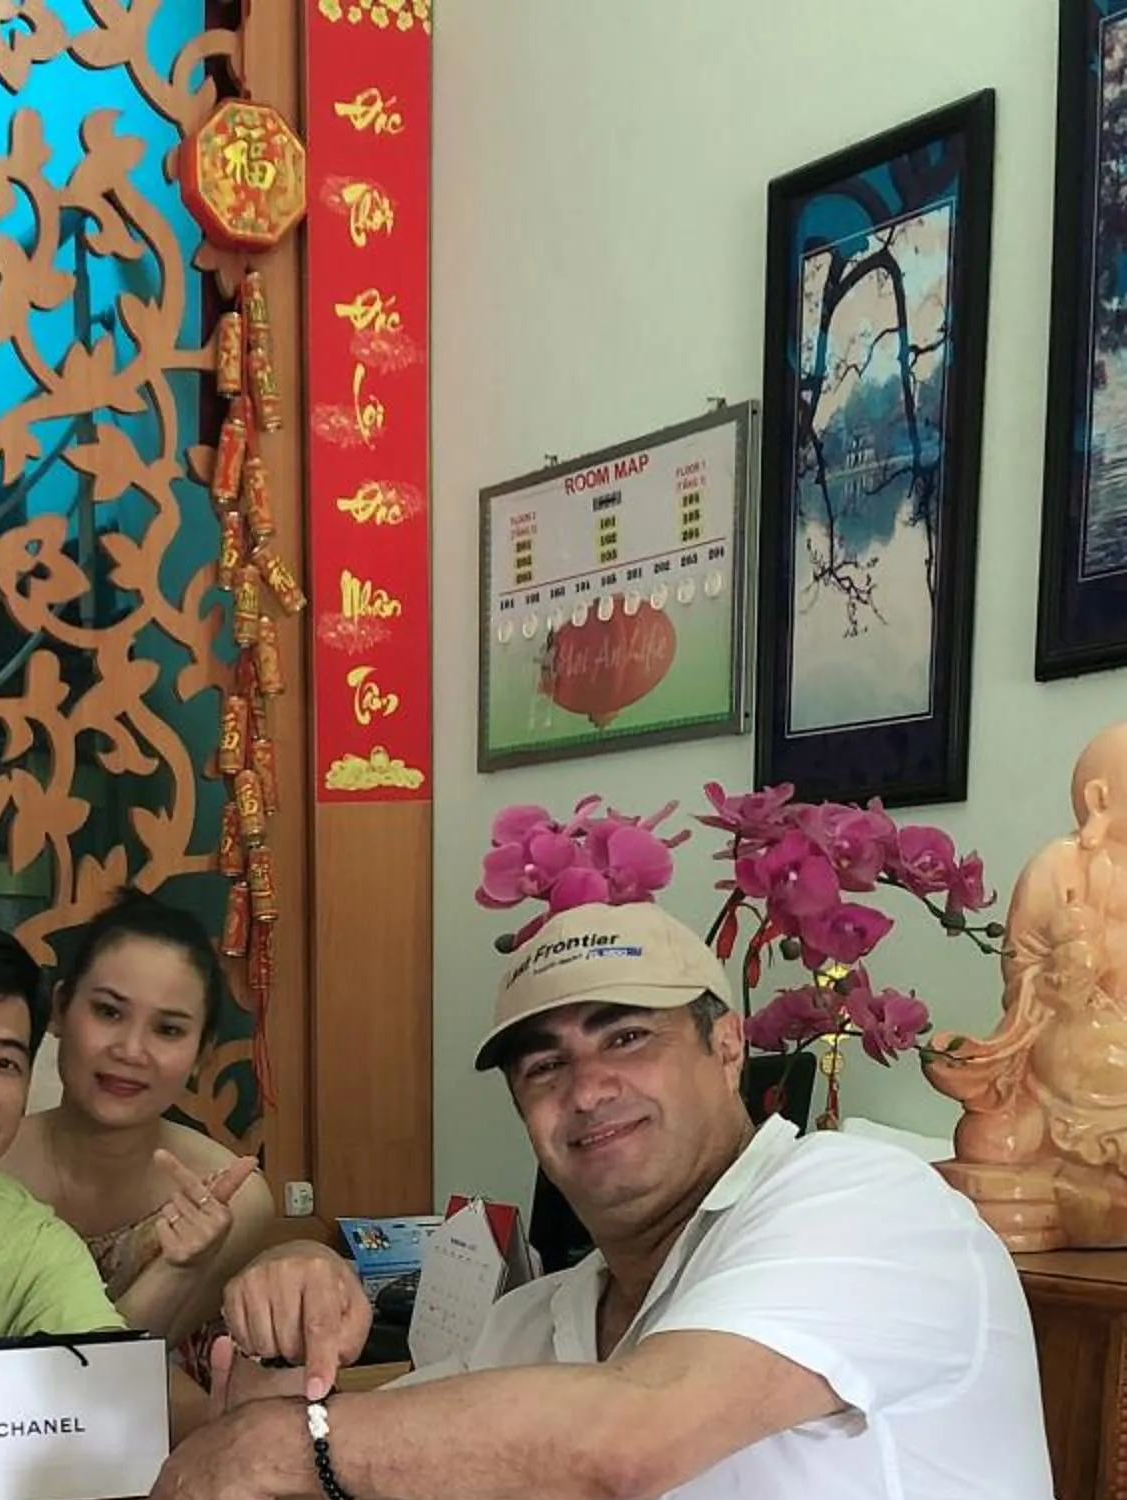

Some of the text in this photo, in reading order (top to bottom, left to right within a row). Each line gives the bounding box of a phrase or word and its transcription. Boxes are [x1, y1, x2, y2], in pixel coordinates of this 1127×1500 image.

[564, 454, 649, 495] ROOM MAP
[533, 931, 619, 963] Frontier
